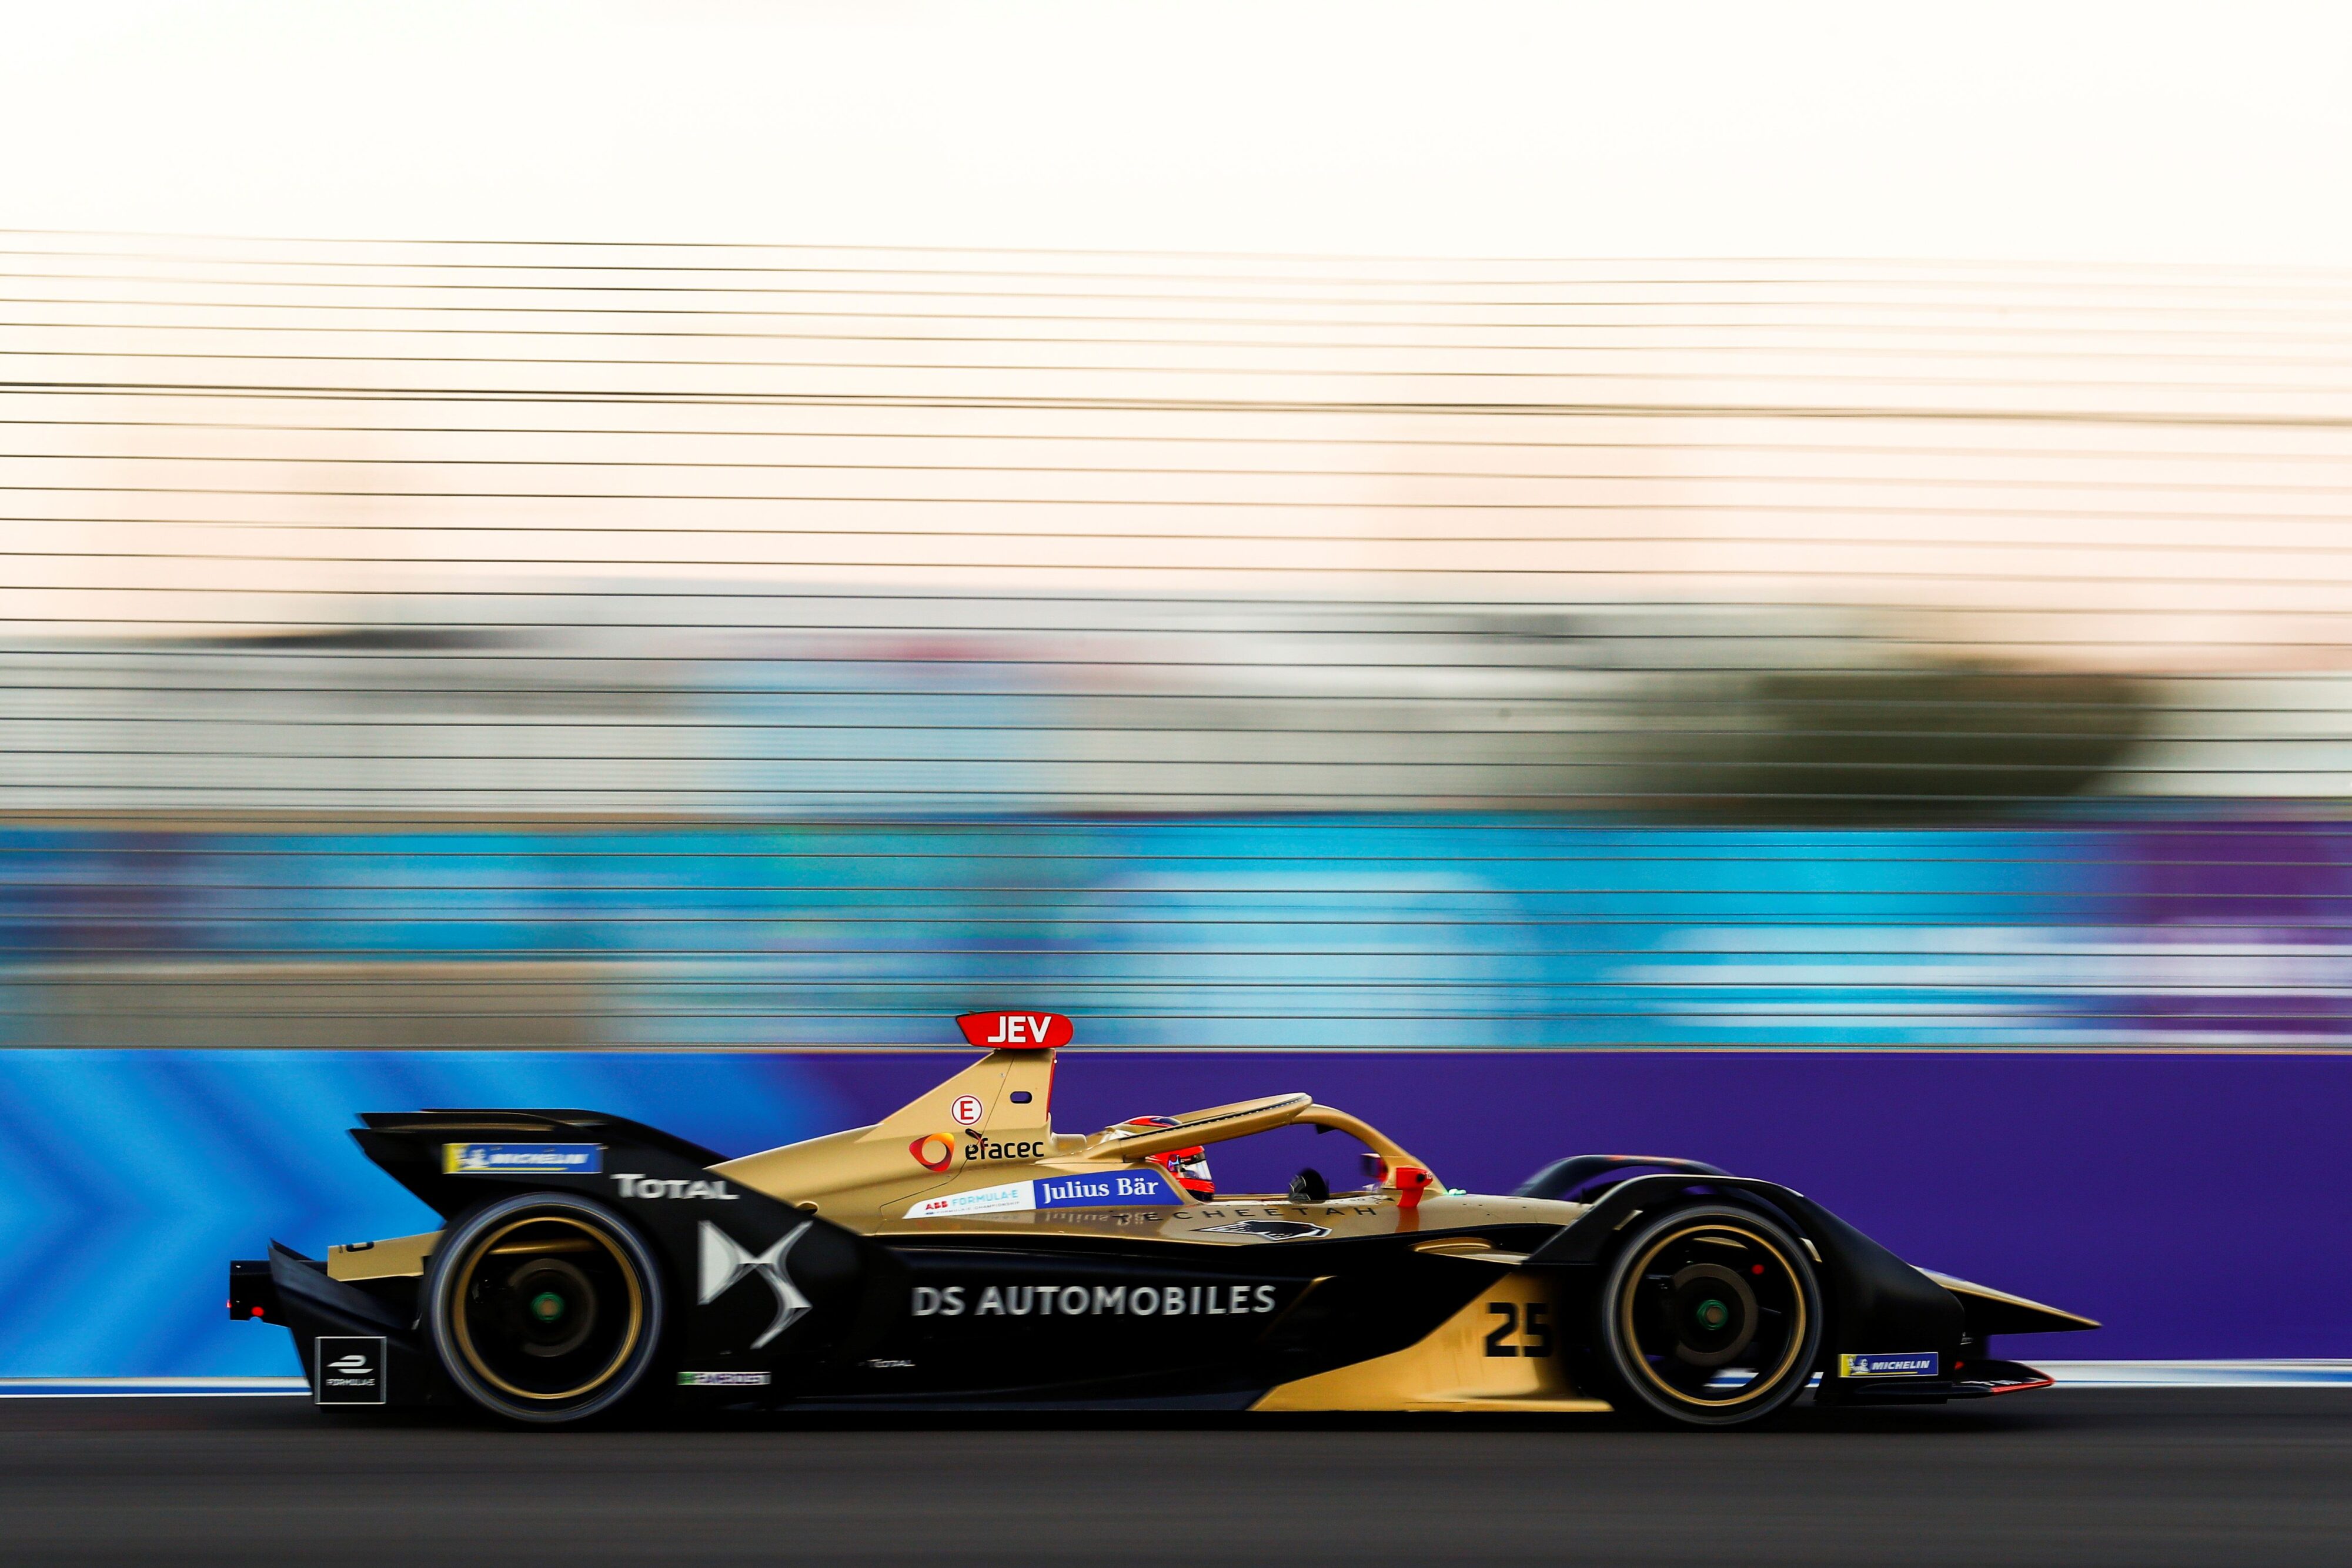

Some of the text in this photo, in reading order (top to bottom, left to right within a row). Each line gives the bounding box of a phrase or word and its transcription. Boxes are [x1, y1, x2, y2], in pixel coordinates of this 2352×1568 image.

[987, 1016, 1052, 1043] JEV
[960, 1101, 974, 1120] E
[965, 1138, 1044, 1160] efacec
[610, 1174, 740, 1200] TOTAL
[1041, 1178, 1158, 1204] Julius Bär
[925, 1201, 948, 1210] ABB
[1111, 1207, 1377, 1223] TECHEETAH
[911, 1285, 1277, 1316] DS AUTOMOBILES
[1484, 1302, 1552, 1358] 25
[1872, 1360, 1930, 1370] MICHELIN
